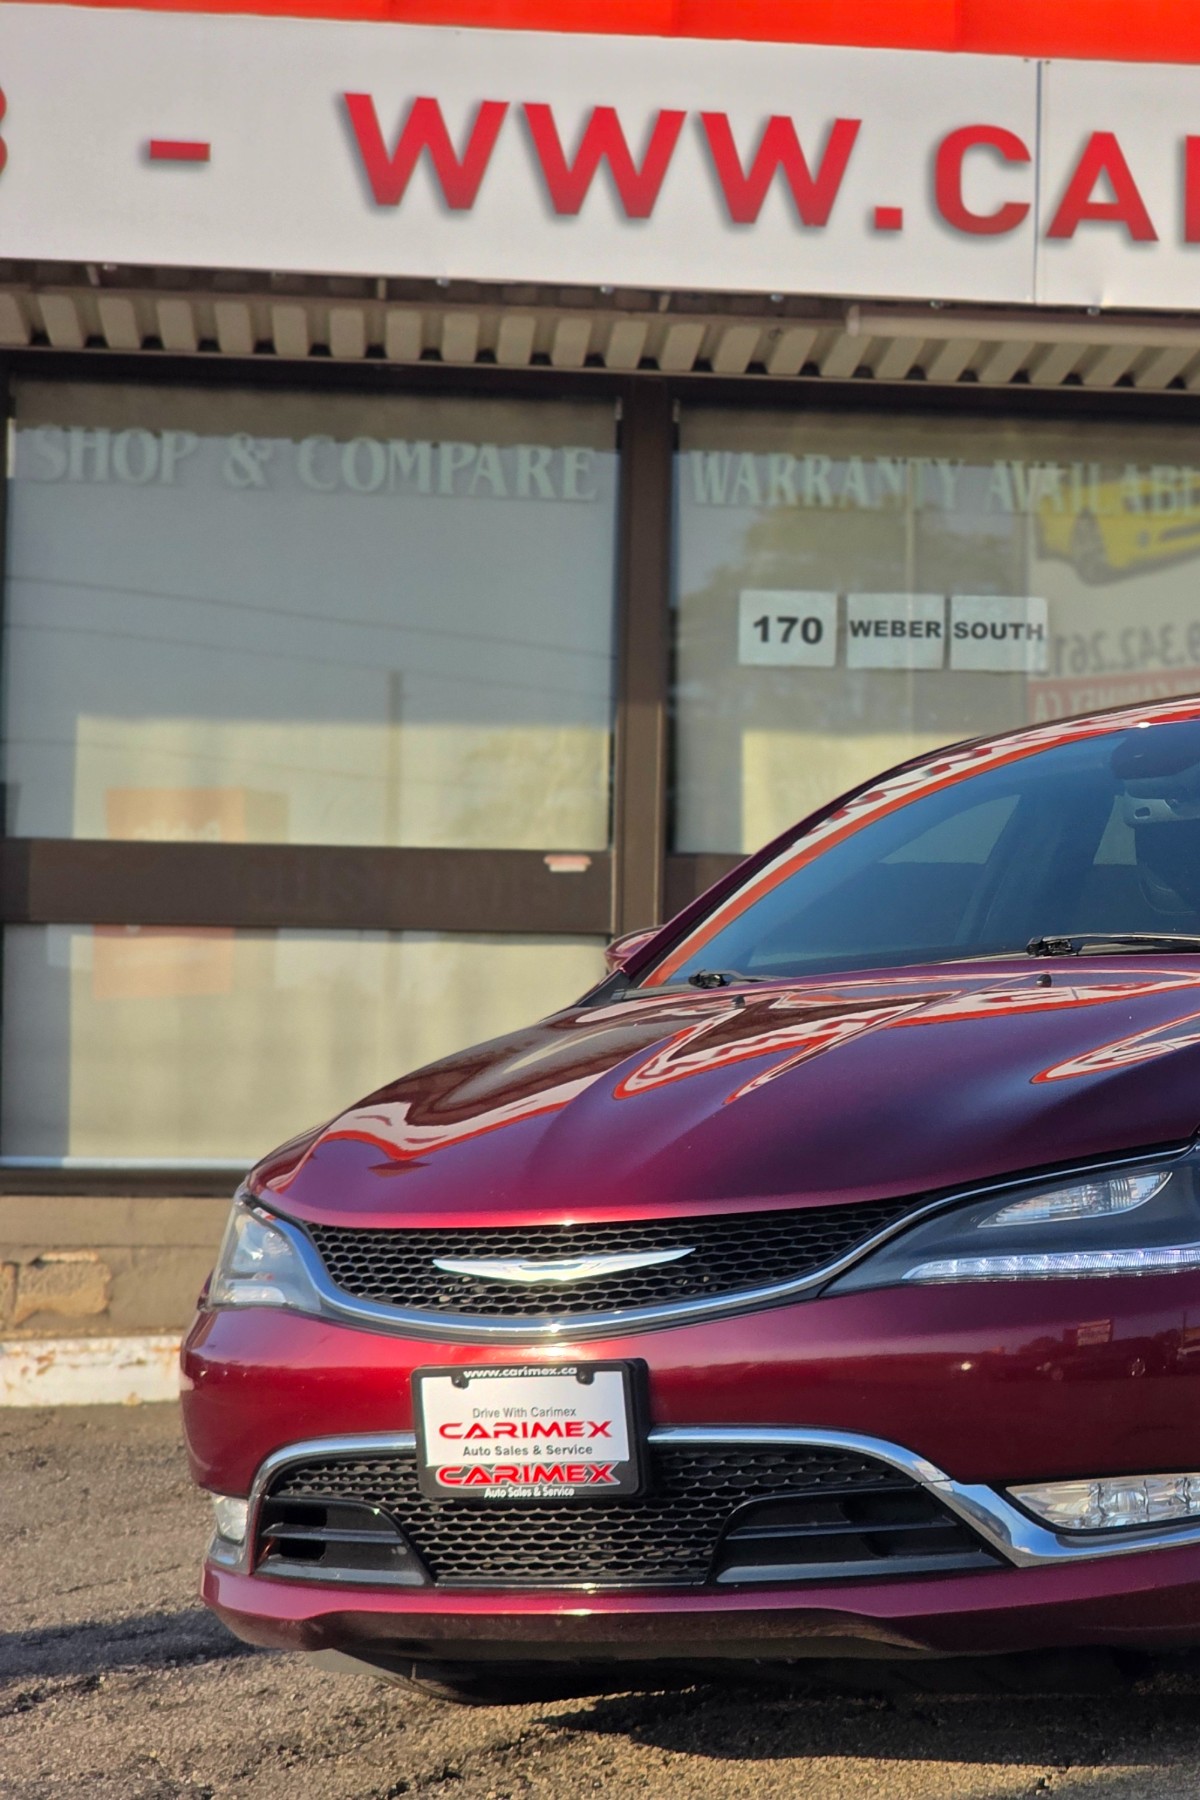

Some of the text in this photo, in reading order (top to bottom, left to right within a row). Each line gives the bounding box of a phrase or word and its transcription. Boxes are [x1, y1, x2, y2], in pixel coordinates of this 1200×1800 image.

[34, 423, 596, 500] SHOP & COMPARE
[689, 450, 966, 510] WARRANTY
[753, 615, 1044, 645] 170 WEBER SOUTH
[463, 1366, 577, 1378] www.carimex.ca
[473, 1407, 576, 1418] Drive With Carimex
[439, 1421, 612, 1439] CARIMEX
[463, 1444, 592, 1456] Auto Sales & Service
[436, 1464, 620, 1486] CARIMEX
[485, 1486, 575, 1498] Auto Sales & Service
